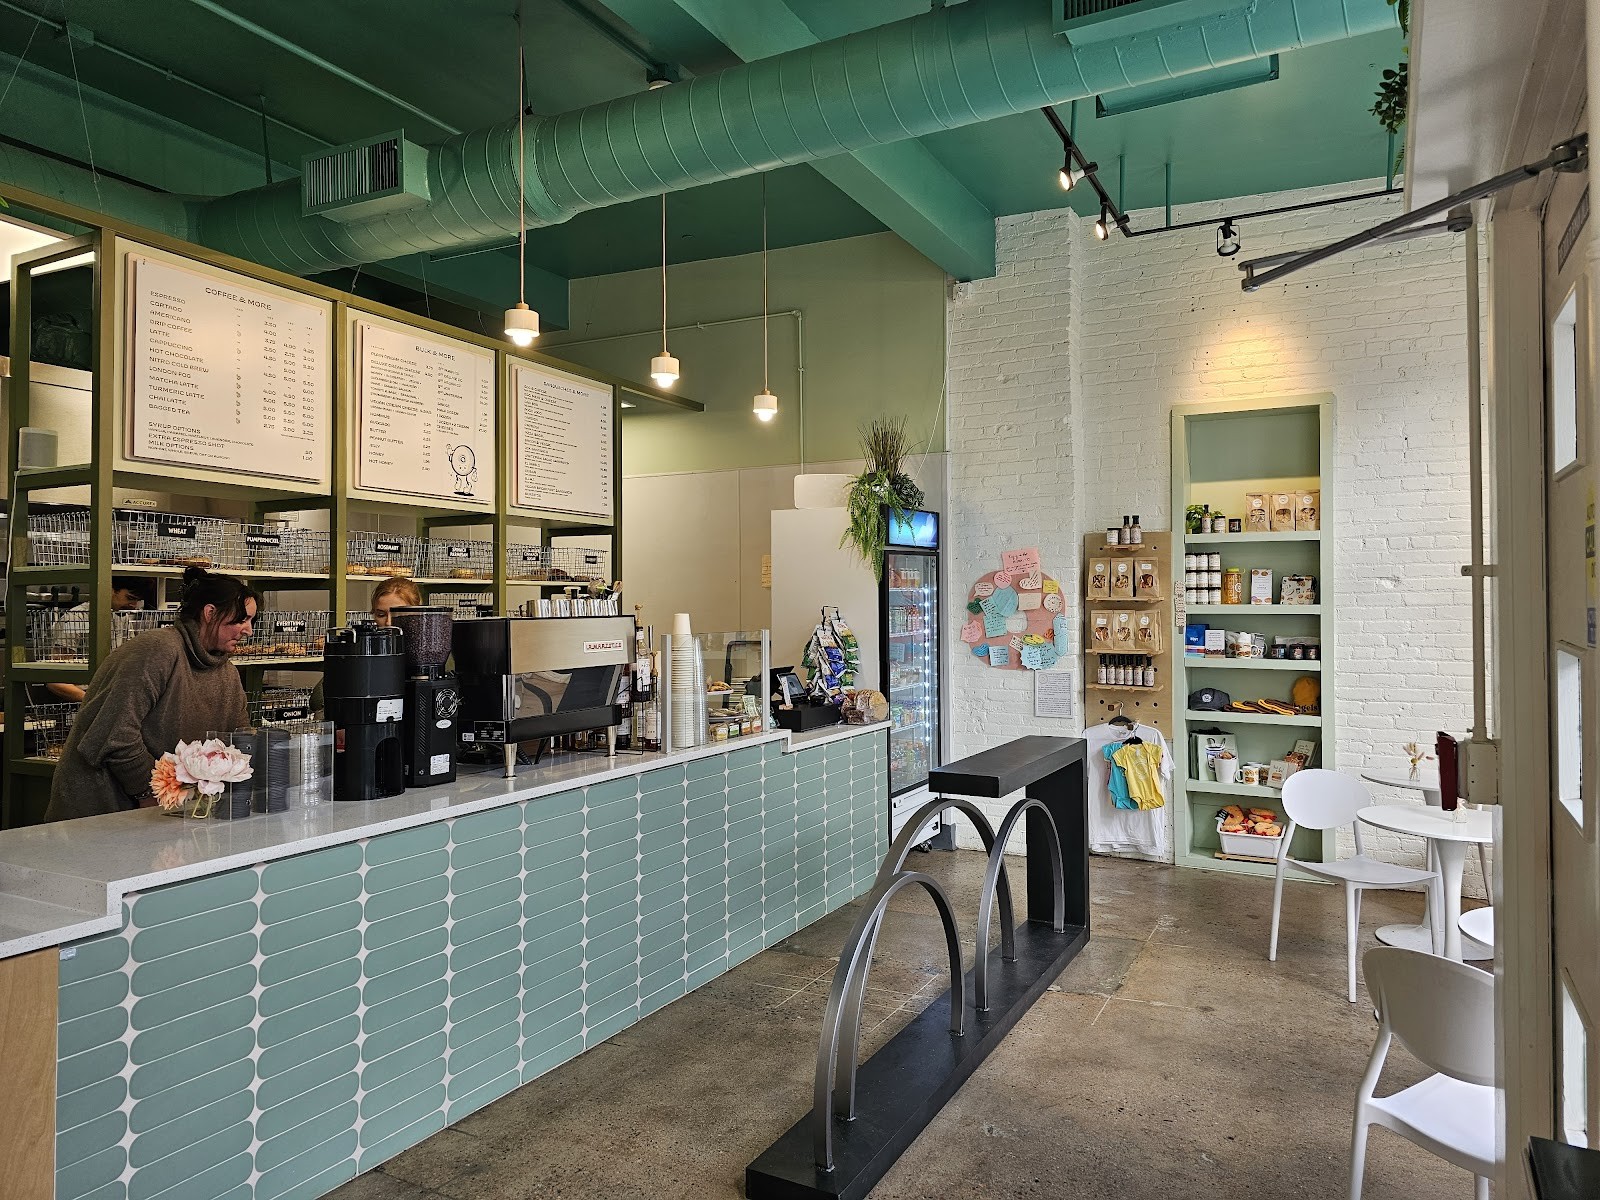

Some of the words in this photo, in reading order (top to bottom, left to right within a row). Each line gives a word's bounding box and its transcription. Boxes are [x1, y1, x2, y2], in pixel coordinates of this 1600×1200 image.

[150, 291, 185, 304] ESPRESSO
[205, 288, 238, 301] COFFEE
[248, 299, 272, 310] MORE
[150, 301, 182, 312] CORTADO
[150, 310, 191, 324] AMERICANO
[150, 329, 170, 337] LATTE
[167, 324, 192, 334] COFFEE
[150, 338, 193, 351] CAPPUCCINO
[165, 350, 203, 363] CHOCOLATE
[415, 345, 432, 355] BULK
[439, 352, 456, 361] MORE
[150, 356, 170, 365] NITRO
[171, 361, 188, 369] COLD
[190, 365, 209, 373] BREW
[150, 366, 177, 376] LONDON
[149, 375, 178, 385] MATCHA
[180, 381, 199, 390] LATTE
[149, 384, 184, 396] TURMERIC
[186, 391, 205, 400] LATTE
[149, 403, 176, 413] BAGGED
[167, 397, 187, 406] LATTE
[148, 421, 172, 429] SYRUP
[172, 425, 201, 434] OPTIONS
[148, 433, 171, 441] EXTRA
[172, 437, 207, 446] ESPRESSO
[208, 441, 225, 449] SHOT
[165, 442, 194, 451] OPTIONS
[168, 527, 188, 535] WHEAT
[246, 536, 279, 544] PUMPERNICKEL
